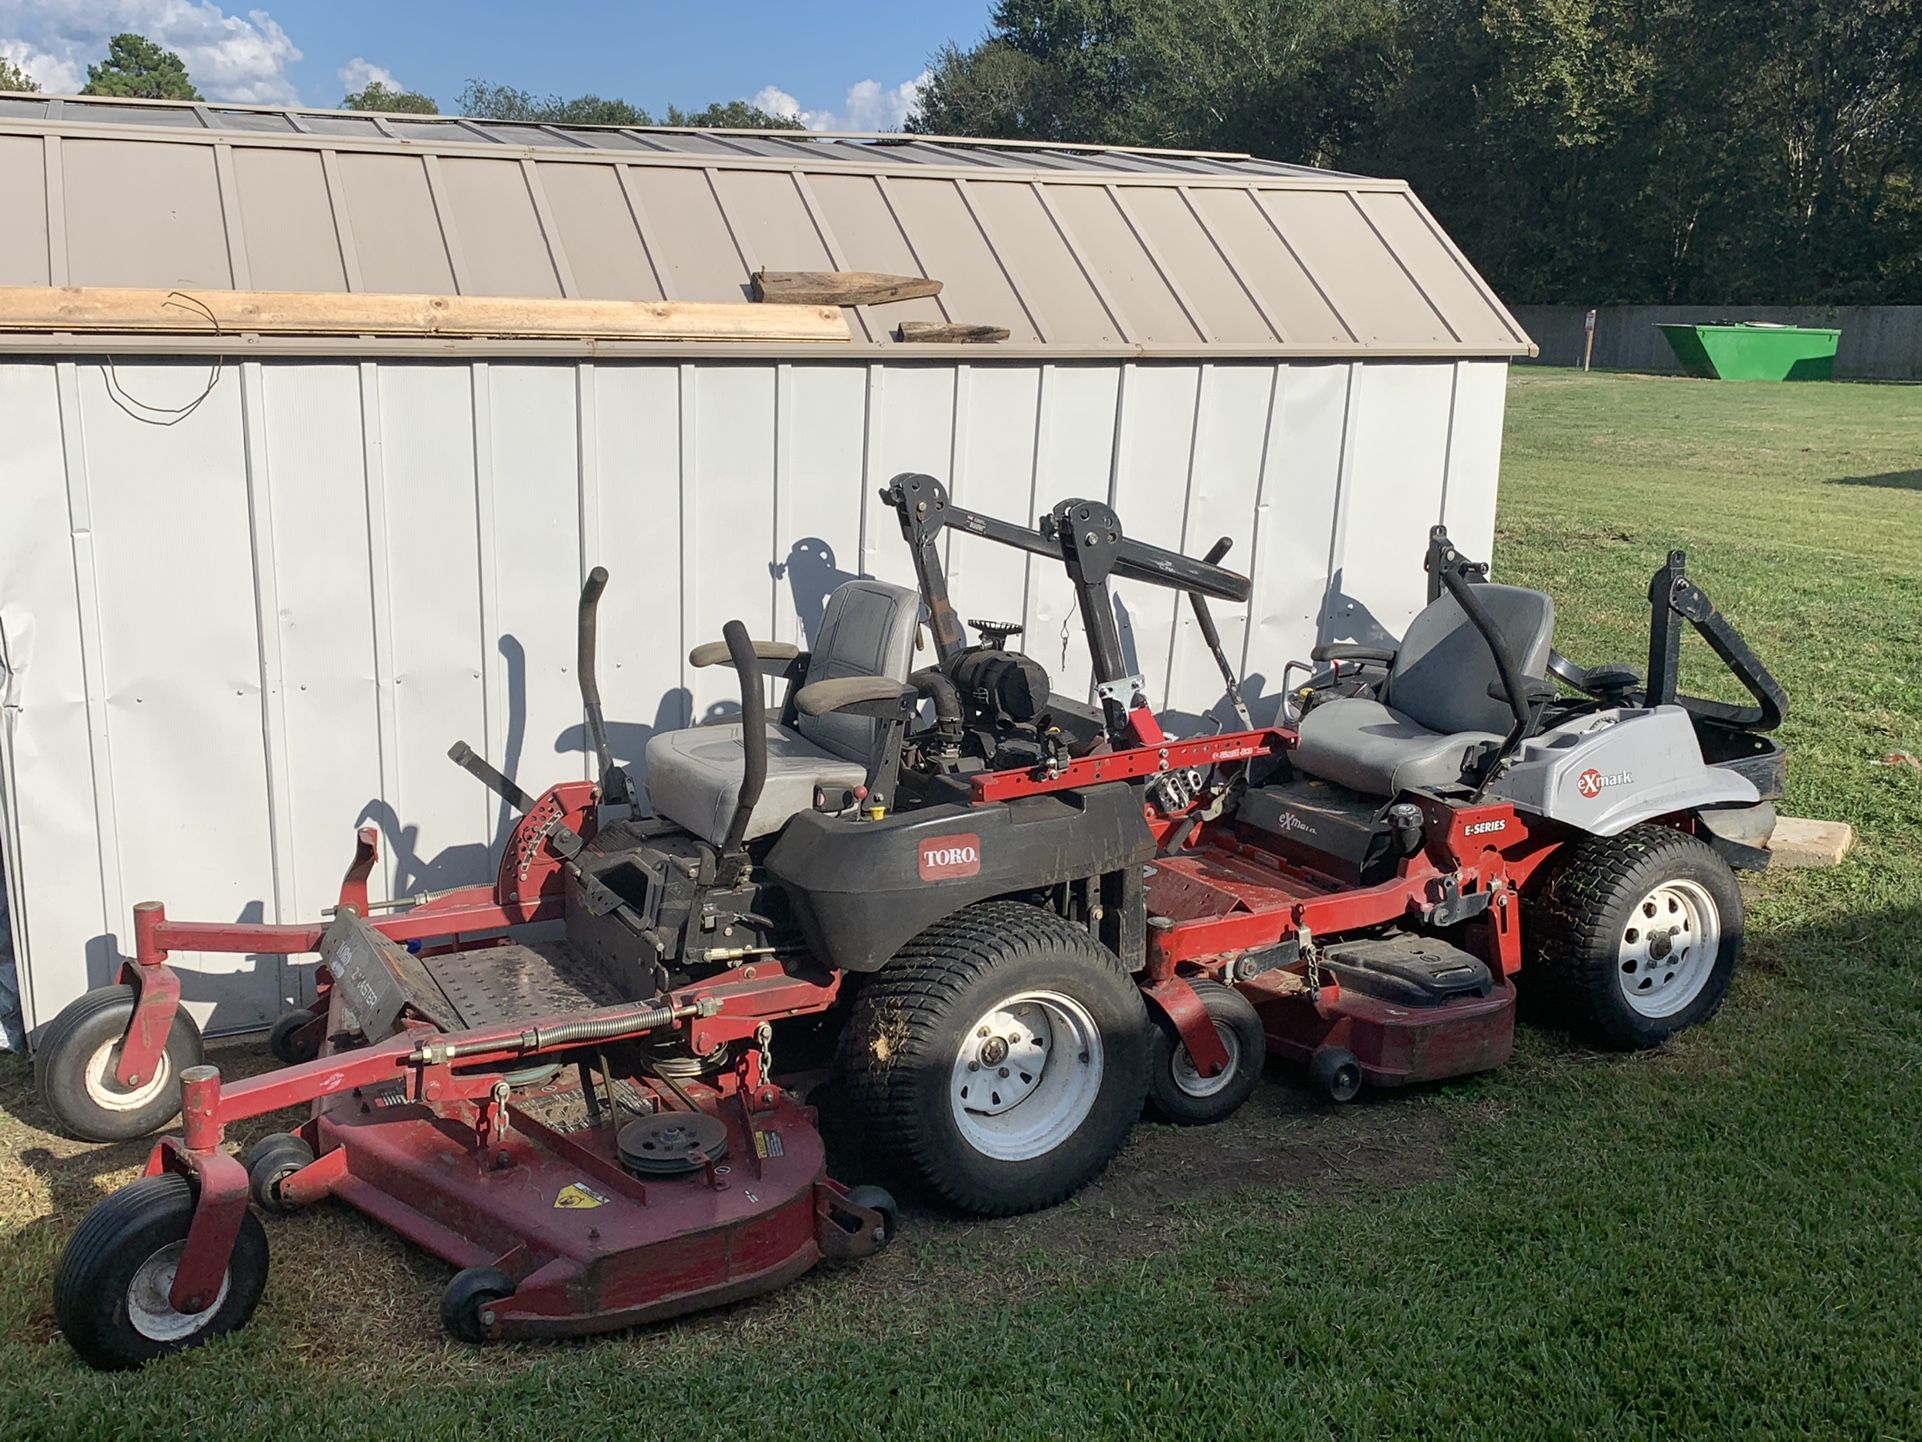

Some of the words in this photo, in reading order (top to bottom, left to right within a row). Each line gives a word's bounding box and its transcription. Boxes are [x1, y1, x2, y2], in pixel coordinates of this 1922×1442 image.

[1578, 769, 1632, 794] eXmark
[1464, 819, 1506, 836] E-SERIES
[924, 846, 975, 868] TORO
